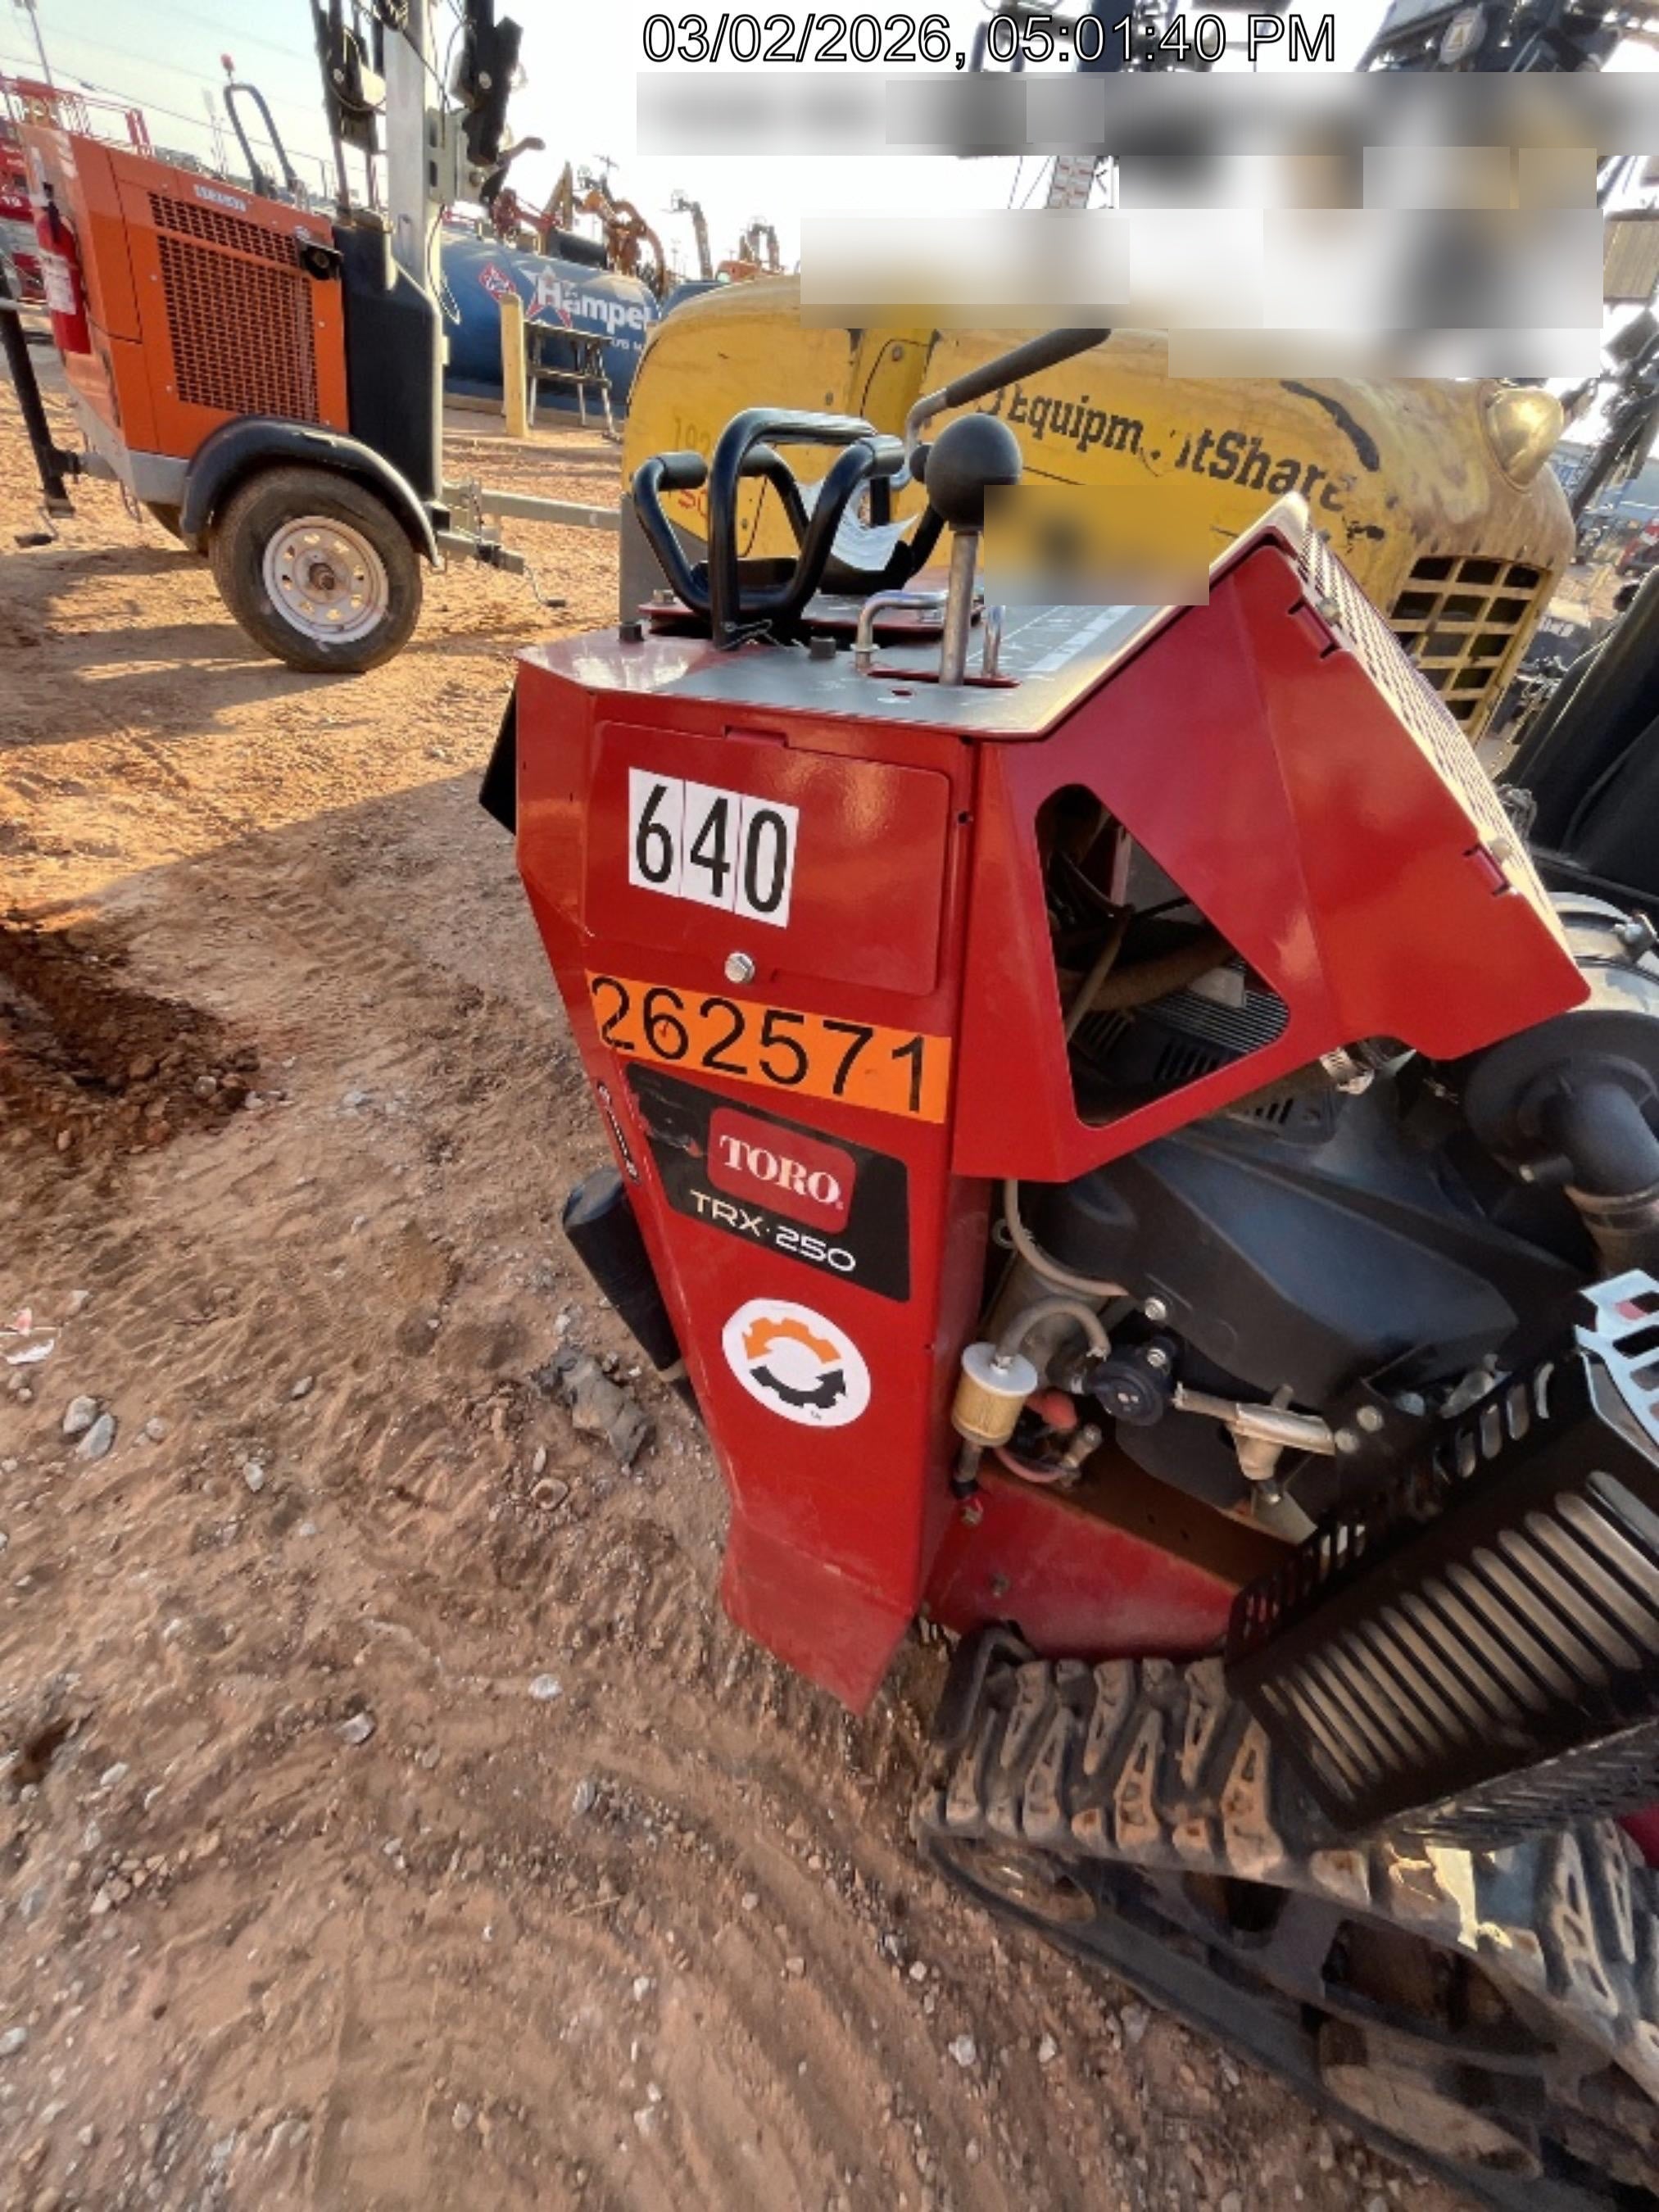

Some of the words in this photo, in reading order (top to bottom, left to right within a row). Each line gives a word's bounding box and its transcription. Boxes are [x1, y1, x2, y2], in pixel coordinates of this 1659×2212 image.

[636, 783, 787, 913] 640
[592, 976, 924, 1113] 262571
[719, 1135, 841, 1204] TORO
